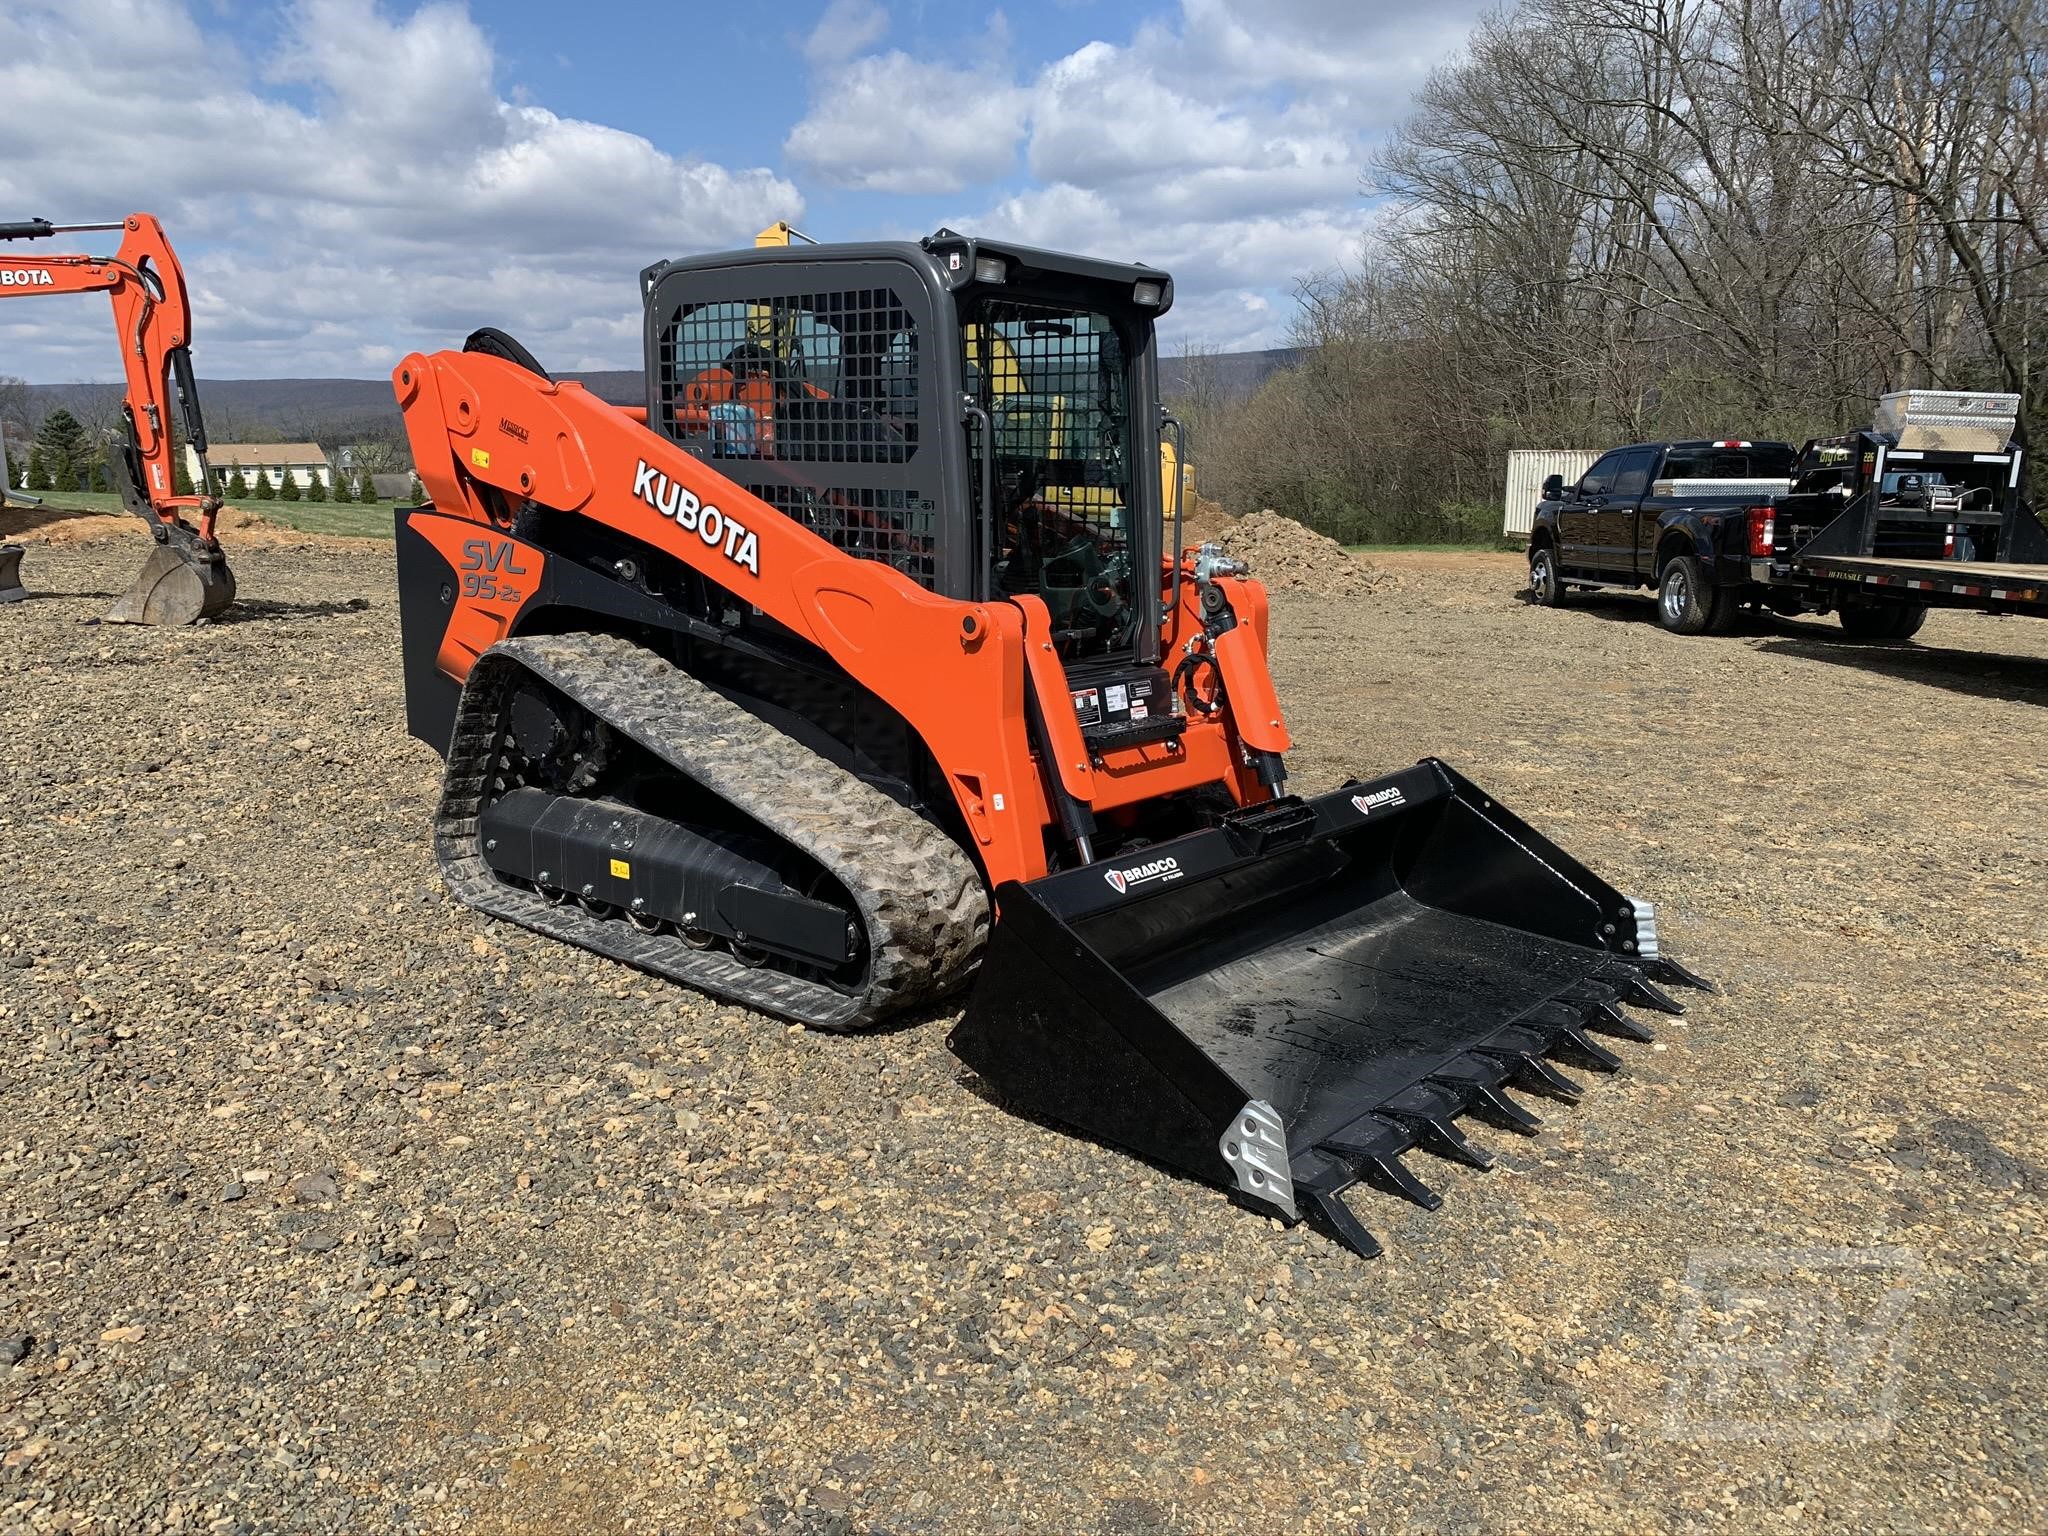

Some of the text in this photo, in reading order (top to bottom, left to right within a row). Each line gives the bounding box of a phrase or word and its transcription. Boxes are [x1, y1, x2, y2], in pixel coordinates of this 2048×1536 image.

[0, 269, 54, 286] BOTA
[633, 459, 759, 576] KUBOTA
[460, 540, 526, 575] SVL
[1363, 787, 1401, 806] BRADCO
[1122, 857, 1178, 882] BRADCO
